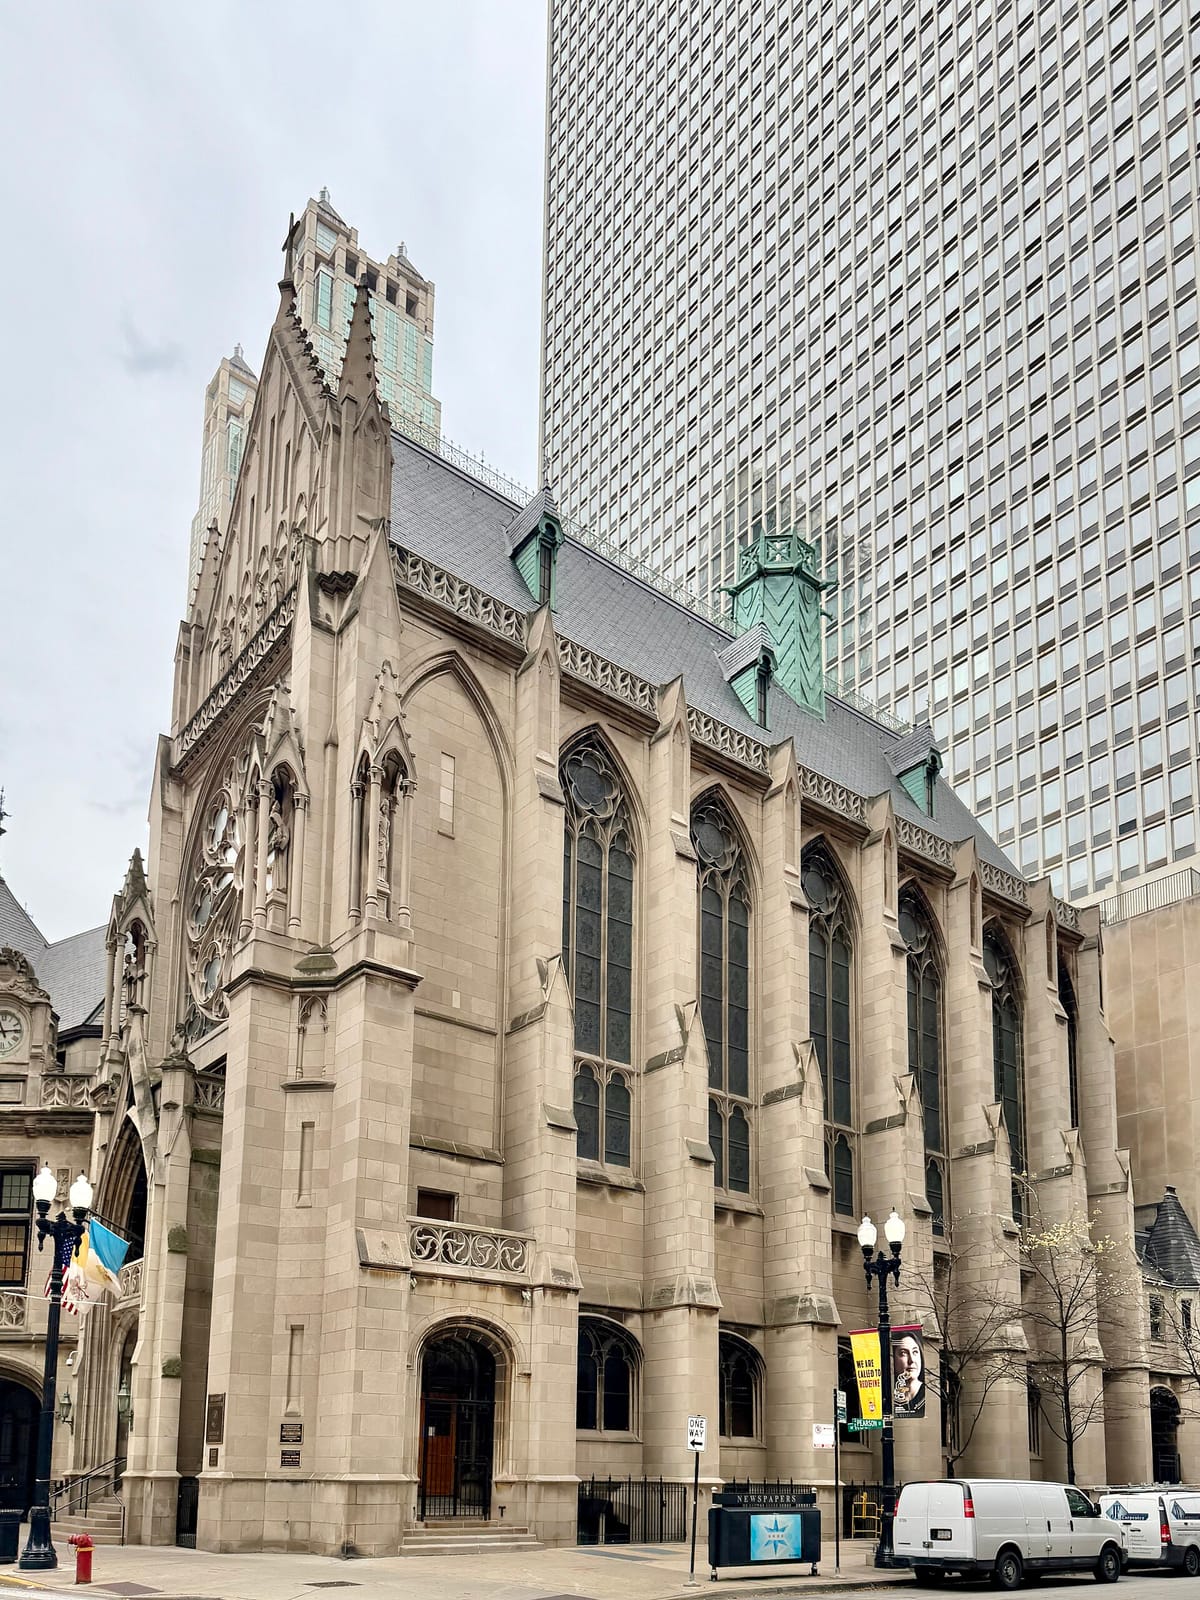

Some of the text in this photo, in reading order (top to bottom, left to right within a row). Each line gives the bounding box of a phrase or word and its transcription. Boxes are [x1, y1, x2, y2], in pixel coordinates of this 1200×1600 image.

[856, 1359, 874, 1368] WE ARE
[858, 1369, 882, 1378] CALLED TO
[690, 1419, 704, 1428] ONE
[689, 1428, 704, 1437] WAY
[737, 1495, 796, 1503] NEWSPAPERS
